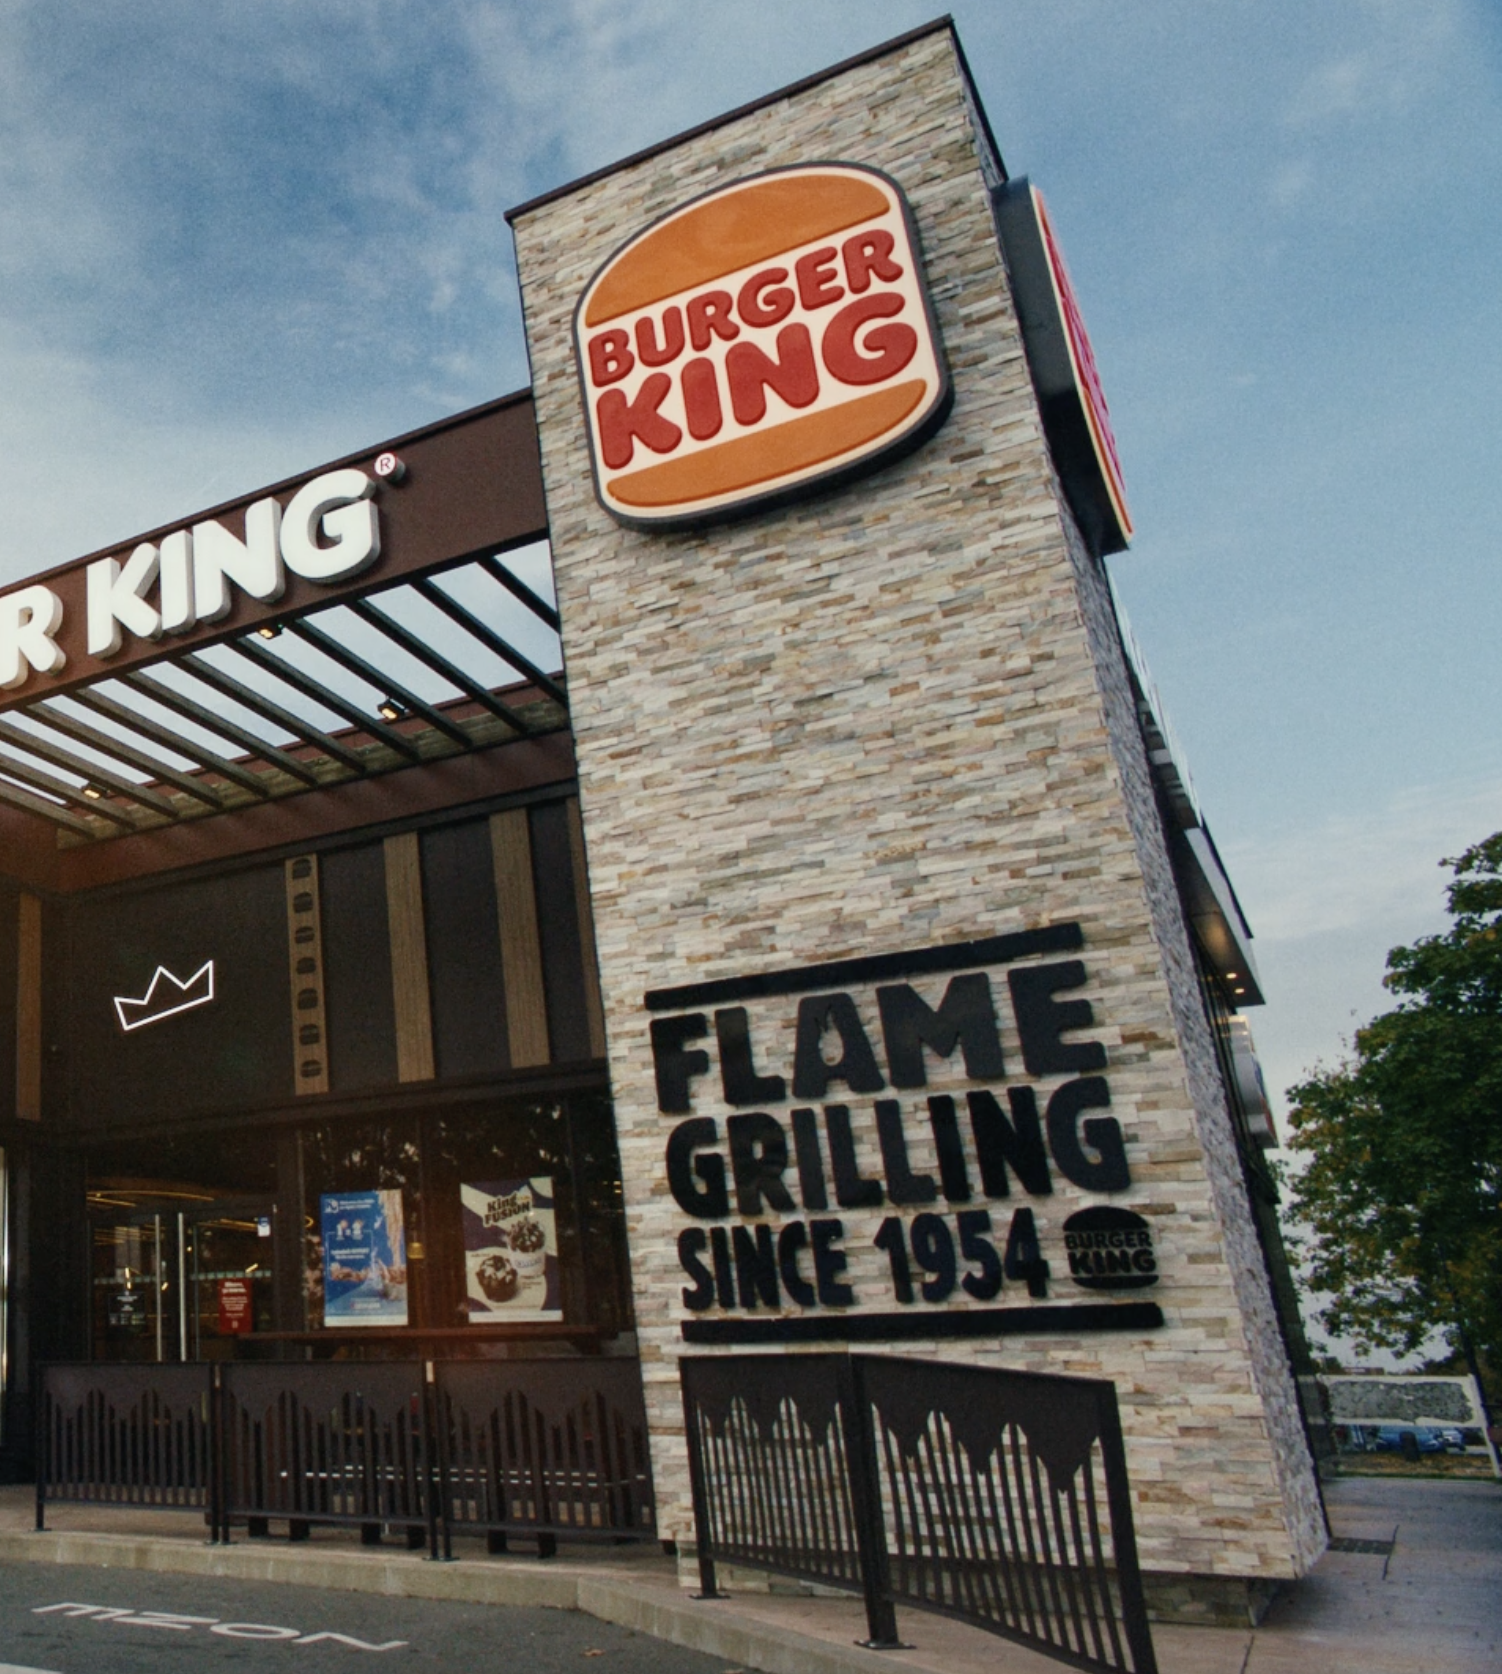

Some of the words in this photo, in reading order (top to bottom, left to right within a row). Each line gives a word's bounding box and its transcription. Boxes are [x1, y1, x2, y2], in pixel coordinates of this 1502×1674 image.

[588, 229, 903, 388] BURGER
[596, 291, 918, 470] KING
[649, 959, 1107, 1114] FLAME
[665, 1075, 1132, 1219] GRILLING
[484, 1202, 531, 1225] FUSION
[487, 1193, 518, 1214] King
[1063, 1230, 1153, 1250] BURGER
[677, 1218, 856, 1311] SINCE
[873, 1207, 1049, 1303] 1954
[1067, 1248, 1157, 1275] KING
[31, 1602, 410, 1652] ZONE
